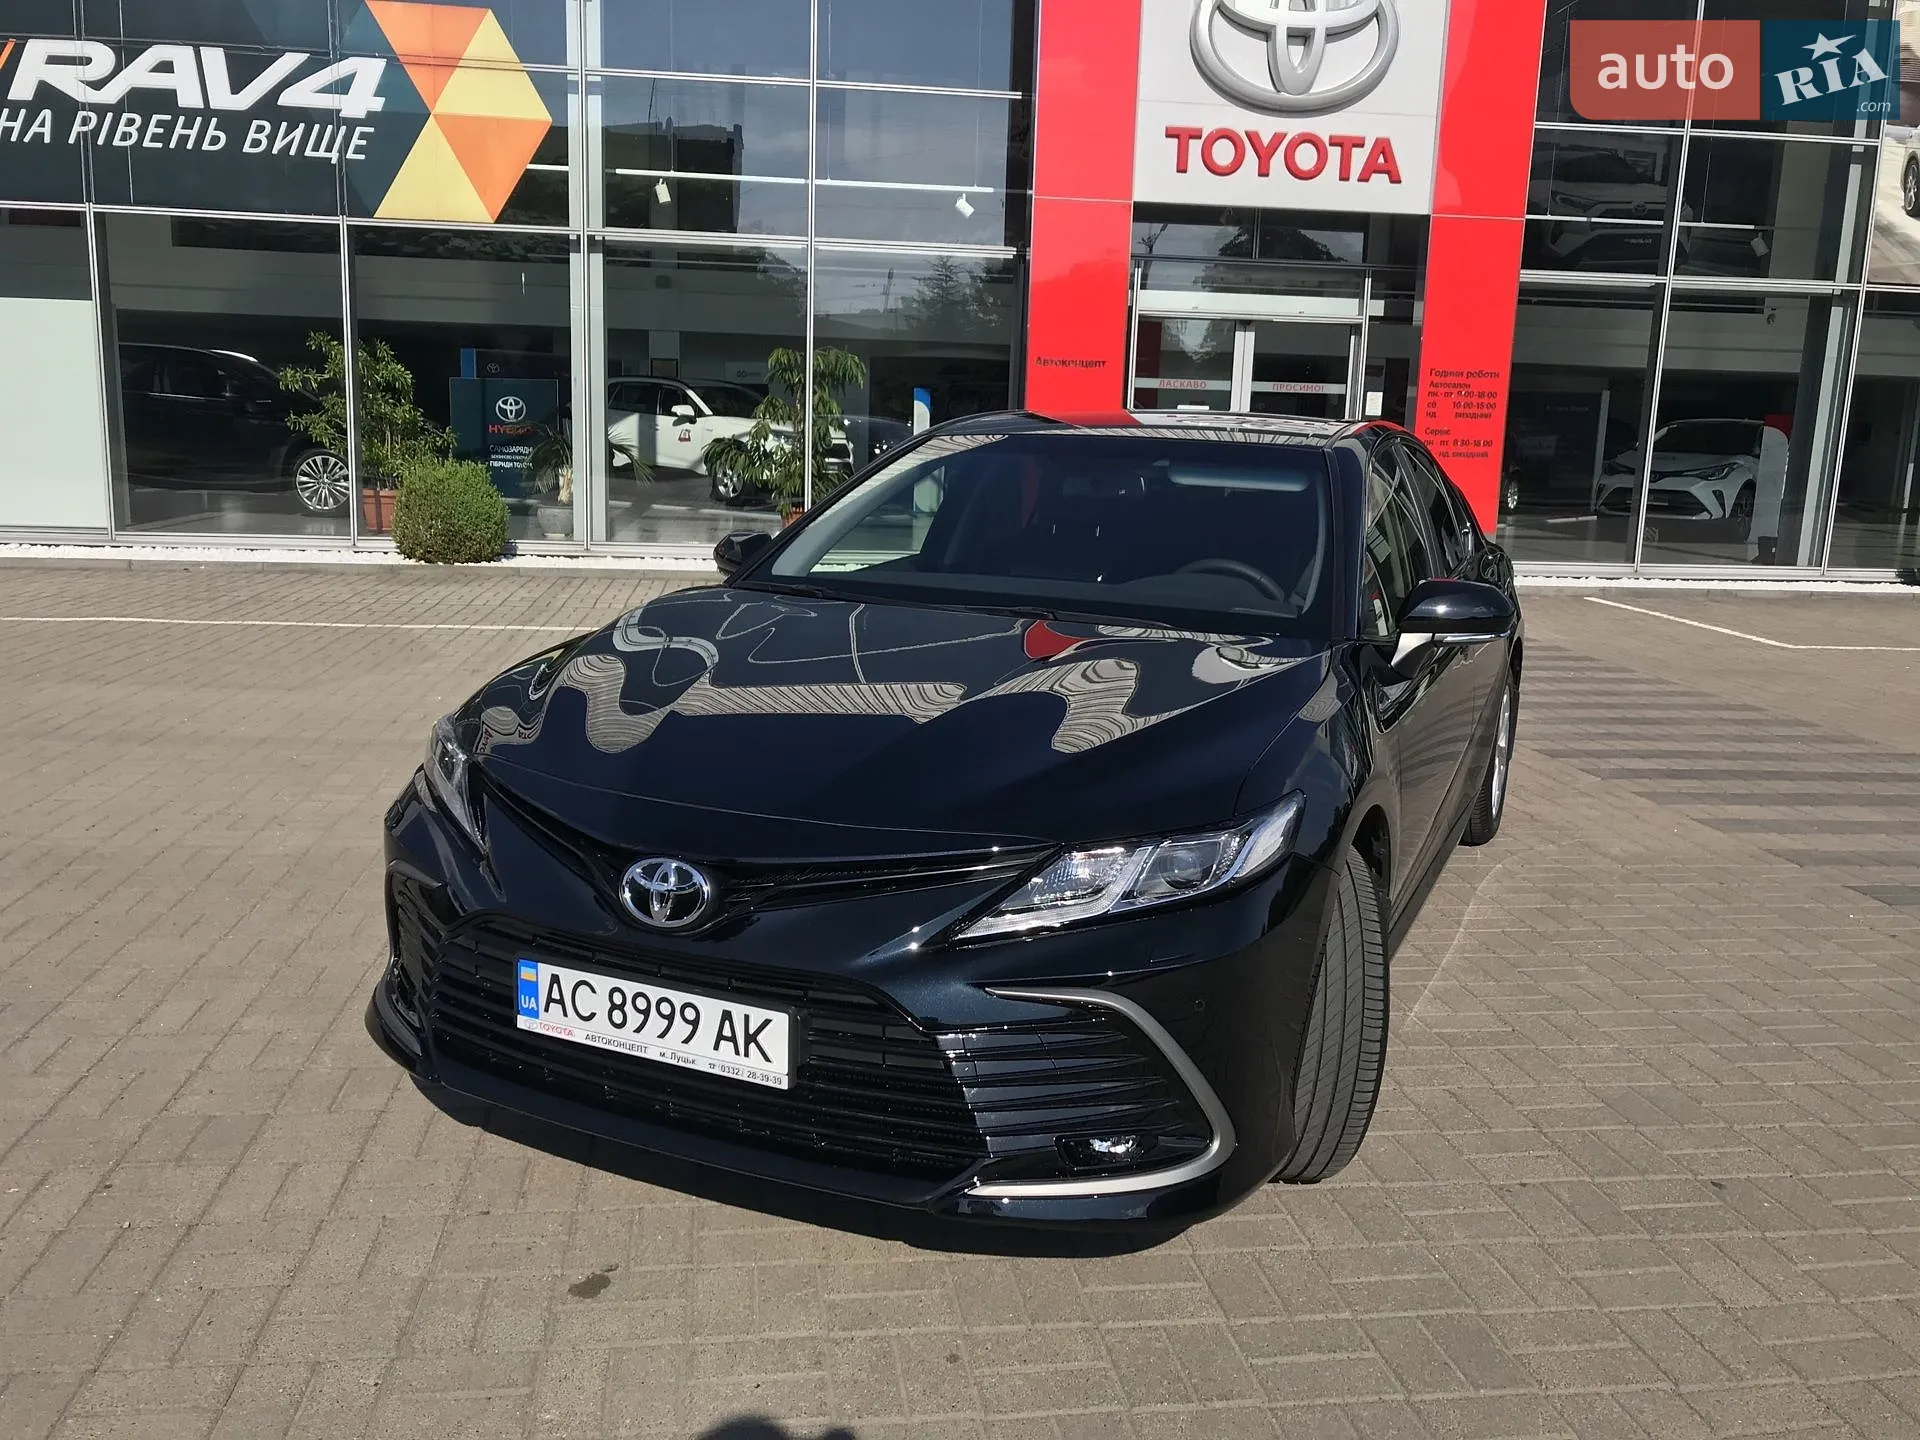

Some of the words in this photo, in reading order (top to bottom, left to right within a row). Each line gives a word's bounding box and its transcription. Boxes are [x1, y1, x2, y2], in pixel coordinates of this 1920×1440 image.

[7, 39, 387, 119] RAV4
[0, 108, 52, 144] НА
[68, 111, 227, 151] РІВЕНЬ
[242, 120, 375, 164] ВИЩЕ
[1165, 126, 1402, 185] TOYOTA
[1158, 379, 1207, 389] ЛАСКАВО
[1429, 367, 1464, 378] Години
[1466, 370, 1500, 379] роботи
[521, 994, 537, 1011] UA
[543, 973, 597, 1022] AC
[607, 986, 701, 1045] 8999
[712, 1009, 774, 1064] AK
[539, 1021, 574, 1038] TOYOTA
[584, 1033, 648, 1055] АВТОКОНЦЕПТ
[747, 1070, 782, 1086] 28-39-39
